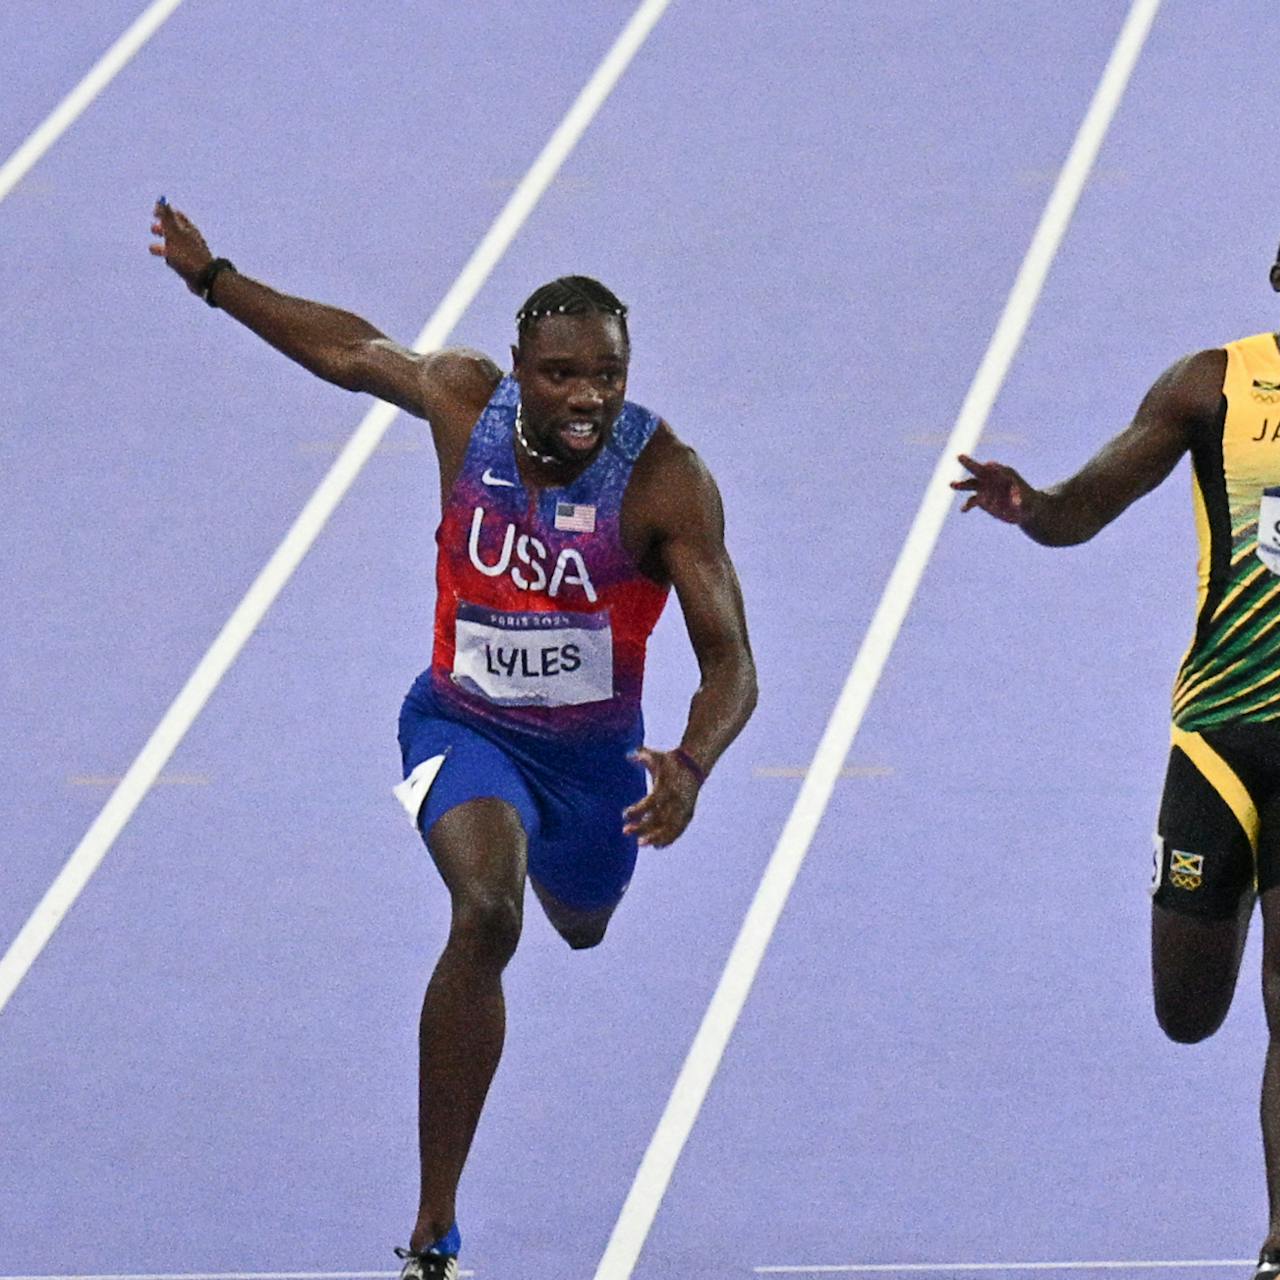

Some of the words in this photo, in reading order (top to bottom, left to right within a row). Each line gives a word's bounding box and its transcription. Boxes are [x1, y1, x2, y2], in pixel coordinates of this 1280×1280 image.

[467, 506, 598, 602] USA
[490, 615, 529, 627] PARIS
[533, 615, 570, 626] 2024
[485, 643, 582, 678] LYLES
